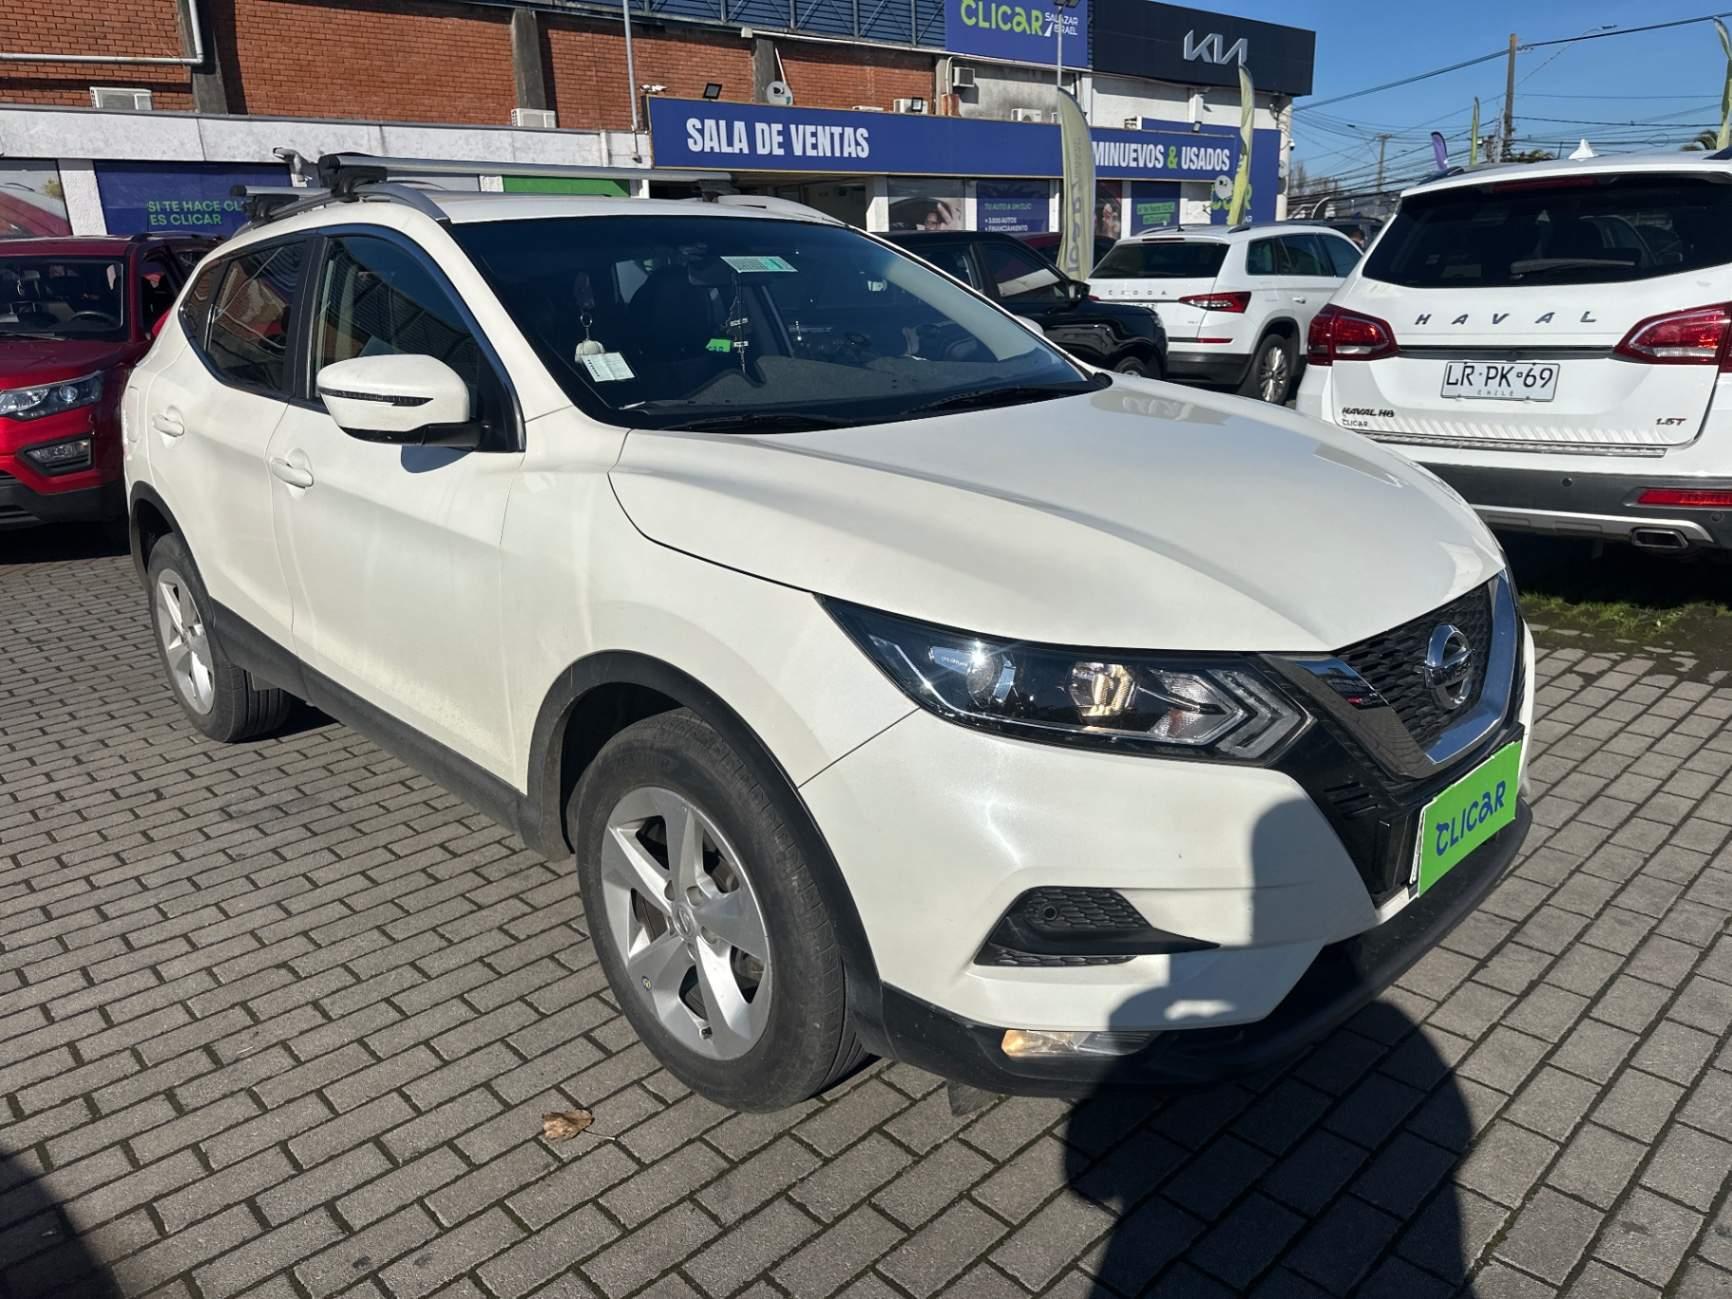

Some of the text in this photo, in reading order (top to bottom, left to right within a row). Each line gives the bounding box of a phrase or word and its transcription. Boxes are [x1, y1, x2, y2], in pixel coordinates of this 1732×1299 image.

[686, 118, 870, 158] SALA DE VENTAS
[1091, 141, 1164, 169] MINUEVOS
[1167, 145, 1178, 169] &
[1181, 146, 1230, 171] USADOS
[147, 201, 160, 212] SI
[162, 201, 180, 211] TE
[183, 201, 221, 211] HACE
[150, 214, 222, 225] ES CLICAR
[1414, 311, 1597, 326] HAVAL
